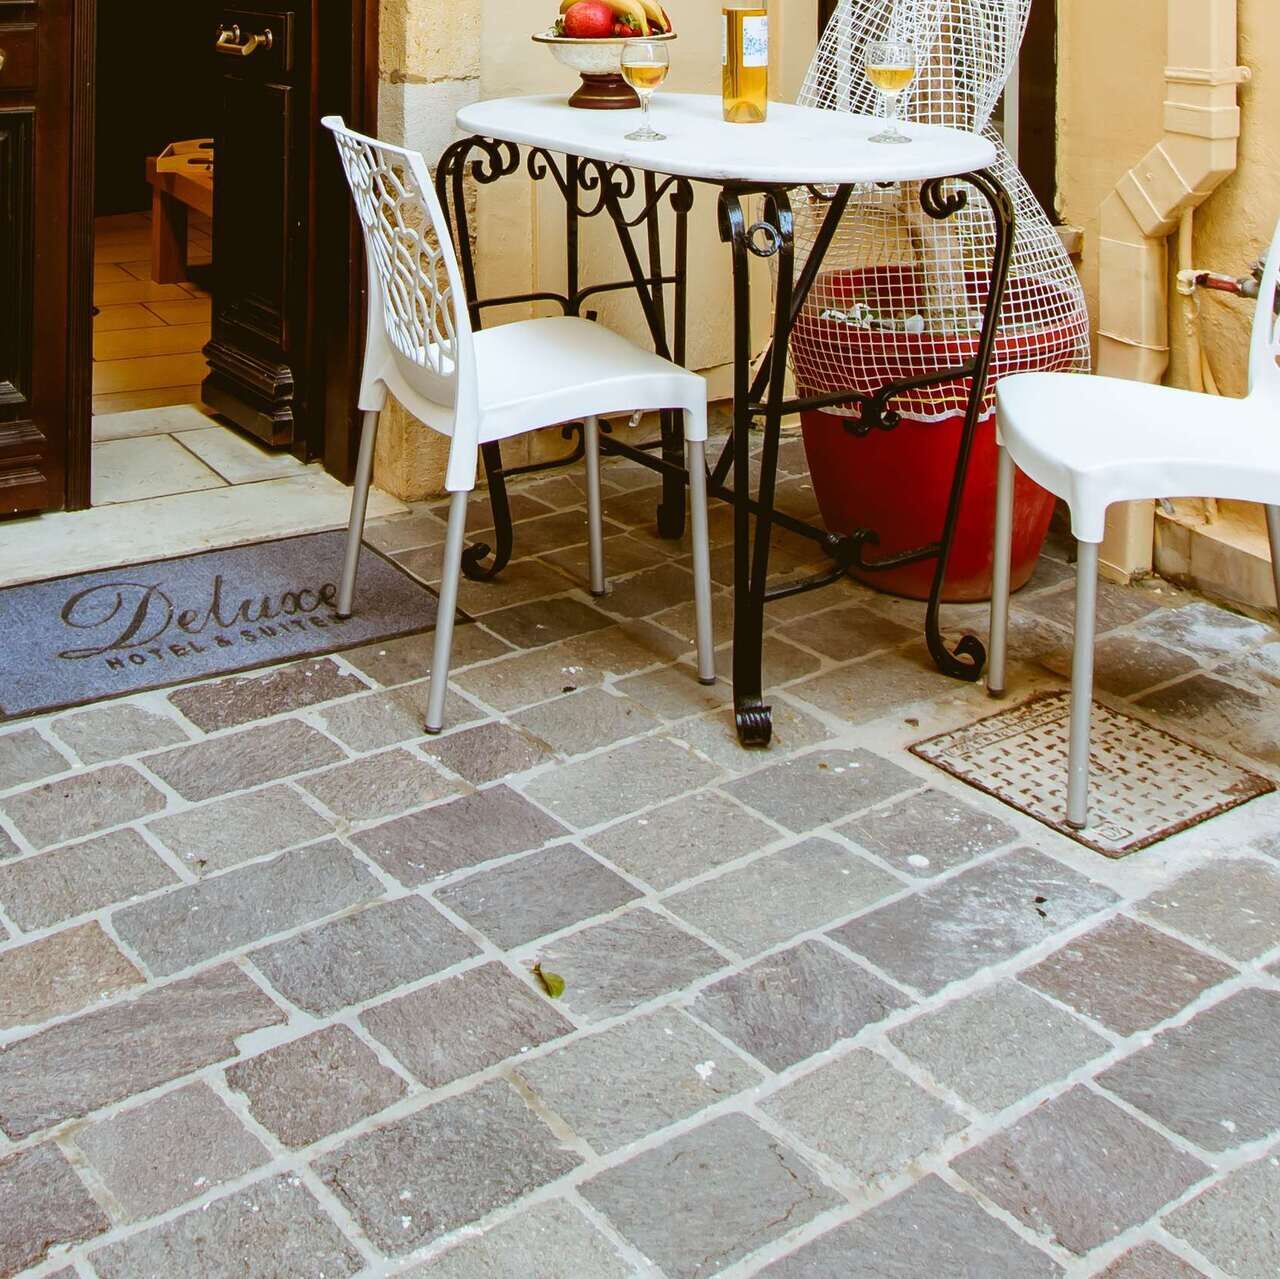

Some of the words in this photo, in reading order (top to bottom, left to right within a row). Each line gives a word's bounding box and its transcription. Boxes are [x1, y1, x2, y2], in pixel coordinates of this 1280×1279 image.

[57, 574, 337, 660] Deluxe
[104, 641, 207, 671] HOTEL
[215, 634, 233, 648] &
